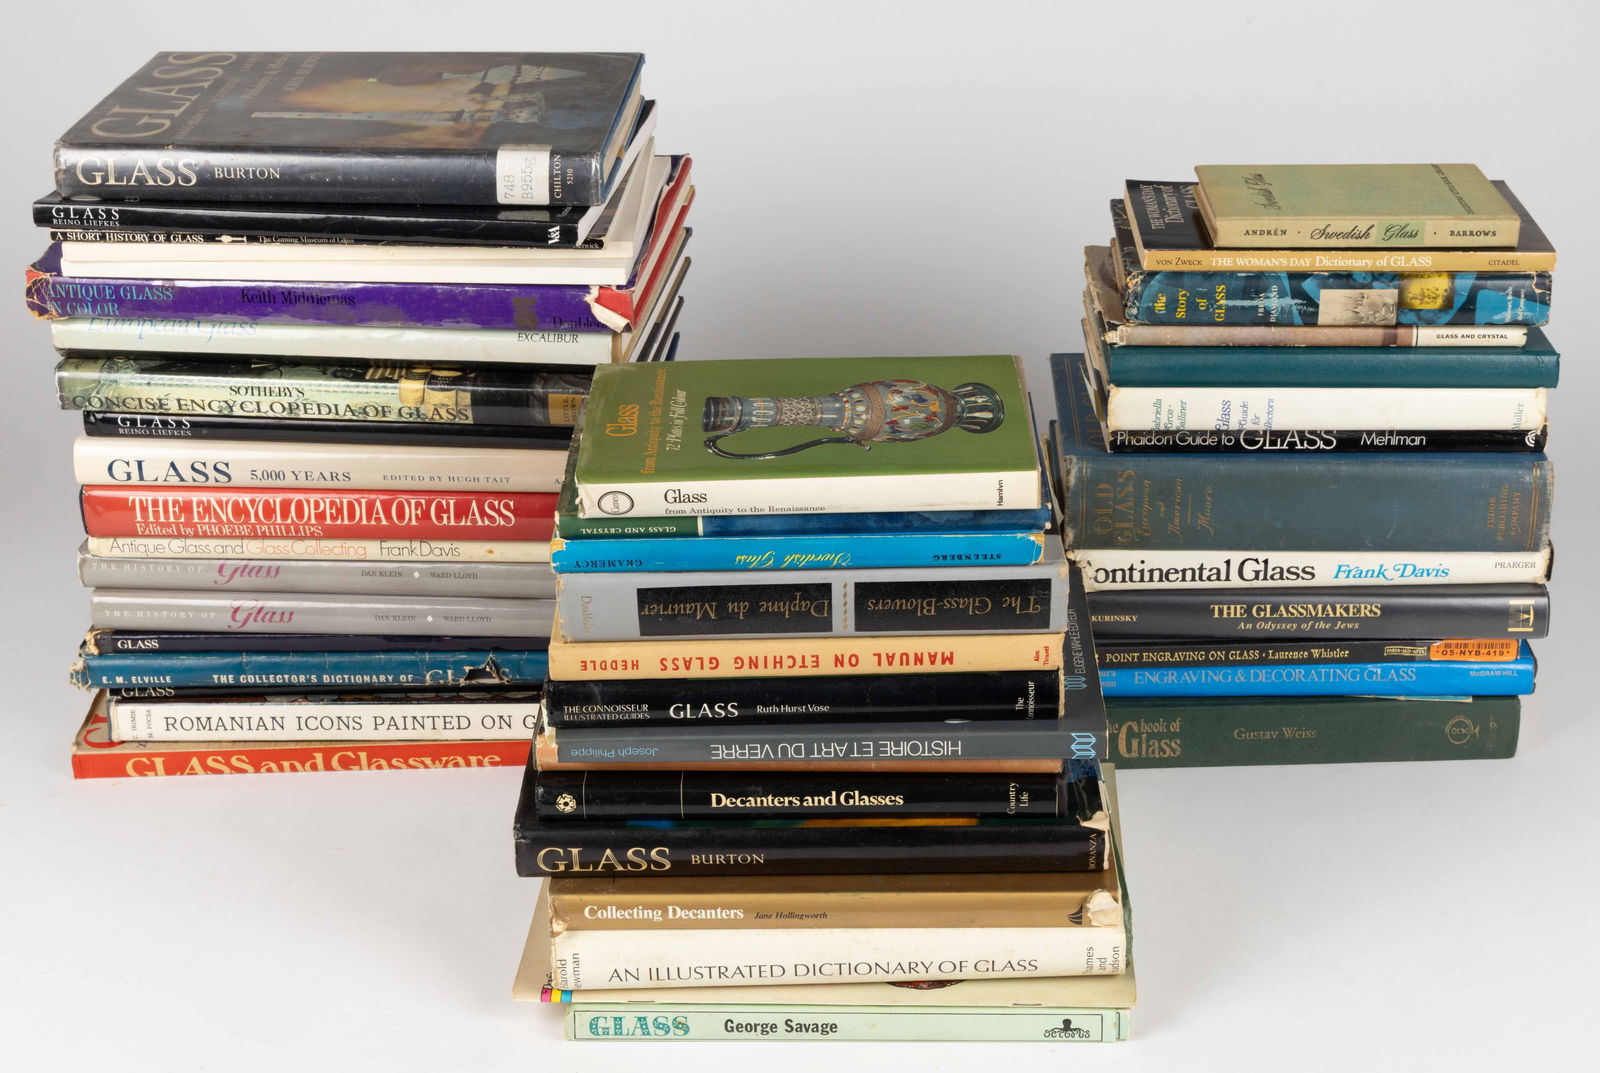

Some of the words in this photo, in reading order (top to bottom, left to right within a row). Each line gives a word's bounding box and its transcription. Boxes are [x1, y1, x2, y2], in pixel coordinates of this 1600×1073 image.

[92, 52, 238, 138] GLASS
[76, 157, 198, 186] GLASS
[214, 167, 281, 180] BURTON
[553, 154, 562, 200] CHILTON
[566, 168, 574, 185] 5210
[503, 174, 516, 201] 748
[52, 206, 120, 220] GLASS
[52, 218, 81, 226] REINO
[83, 219, 120, 227] LIEFKES
[66, 233, 101, 241] SHORT
[105, 233, 150, 242] HISTORY
[153, 234, 168, 242] OF
[170, 234, 204, 243] GLASS
[548, 225, 560, 244] V&A
[1243, 227, 1287, 236] ANDRÉN
[1310, 223, 1375, 240] Swedish
[1382, 223, 1419, 241] Glass
[1209, 257, 1233, 267] THE
[1236, 257, 1287, 267] WOMAN'S
[1289, 257, 1312, 267] DAY
[1315, 256, 1372, 268] Dictionary
[1376, 256, 1389, 267] of
[1390, 256, 1432, 267] GLASS
[46, 285, 116, 301] ANTIQUE
[120, 286, 174, 300] GLASS
[241, 289, 277, 304] Keith
[281, 291, 356, 306] Middlemas
[1175, 288, 1189, 319] Story
[1215, 284, 1227, 322] GLASS
[1270, 285, 1278, 322] DIAMOND
[517, 332, 579, 343] EXCALIBUR
[229, 386, 305, 398] SOTHEBY'S
[71, 395, 170, 411] CONCISE
[176, 398, 355, 417] ENCYCLOPEDIA
[362, 404, 392, 418] OF
[397, 405, 470, 421] GLASS
[605, 404, 640, 438] Glass
[1117, 432, 1173, 446] Phaidon
[1176, 432, 1218, 446] Guide
[1221, 433, 1235, 446] to
[1240, 430, 1337, 450] GLASS
[1361, 431, 1426, 446] Mehlman
[107, 459, 233, 484] GLASS
[250, 470, 286, 482] 5,000
[290, 470, 351, 482] YEARS
[663, 489, 708, 504] Glass
[129, 496, 185, 523] THE
[192, 496, 389, 525] ENCYCLOPEDIA
[391, 498, 426, 526] OF
[430, 499, 515, 527] GLASS
[664, 507, 687, 516] from
[689, 506, 734, 516] Antiquity
[738, 506, 747, 514] to
[749, 505, 766, 514] the
[768, 503, 826, 514] Renaissance
[137, 524, 178, 536] Edited
[180, 524, 195, 537] by
[198, 524, 253, 537] PHOEBE
[256, 525, 324, 537] PHILLIPS
[580, 526, 622, 535] CRYSTAL
[624, 526, 646, 534] AND
[109, 538, 166, 556] Antique
[168, 538, 212, 555] Glass
[214, 538, 244, 556] and
[245, 538, 290, 556] Glass
[290, 539, 368, 560] Collecting
[379, 540, 419, 557] Frank
[419, 540, 461, 558] Davis
[1237, 557, 1316, 582] Glass
[1332, 564, 1393, 582] Frank
[1393, 562, 1450, 579] Davis
[1494, 561, 1537, 569] PRAEGER
[640, 601, 718, 620] Maurier
[727, 601, 749, 620] du
[759, 592, 829, 619] Daphne
[867, 597, 993, 617] Glass-Blowers
[1002, 595, 1042, 615] The
[1091, 614, 1139, 622] KURINSKY
[1210, 604, 1247, 618] THE
[1251, 603, 1382, 618] GLASSMAKERS
[117, 639, 160, 649] GLASS
[659, 656, 720, 672] GLASS
[733, 654, 820, 670] ETCHING
[833, 653, 860, 667] ON
[873, 651, 955, 667] MANUAL
[1105, 653, 1140, 663] POINT
[1142, 650, 1206, 662] ENGRAVING
[1208, 650, 1226, 661] ON
[1228, 650, 1260, 660] GLASS
[1267, 649, 1308, 660] Laurence
[1310, 648, 1350, 659] Whistler
[580, 659, 640, 671] HEDDLE
[115, 675, 128, 684] M.
[131, 675, 172, 684] ELVILLE
[212, 674, 235, 684] THE
[239, 674, 318, 684] COLLECTOR'S
[323, 674, 394, 684] DICTIONARY
[400, 674, 414, 683] OF
[1133, 670, 1232, 685] ENGRAVING
[1255, 667, 1363, 683] DECORATING
[1363, 667, 1417, 682] GLASS
[562, 705, 581, 714] THE
[582, 704, 649, 714] CONNOISSEUR
[669, 702, 739, 719] GLASS
[756, 704, 779, 714] Ruth
[780, 704, 807, 714] Hurst
[807, 703, 830, 713] Vose
[564, 713, 615, 722] ILLUSTRATED
[615, 712, 651, 721] GUIDES
[164, 716, 285, 732] ROMANIAN
[296, 715, 363, 731] ICONS
[372, 715, 471, 731] PAINTED
[481, 715, 513, 730] ON
[570, 747, 615, 758] Philippe
[616, 746, 659, 758] Joseph
[710, 743, 775, 760] VERRE
[777, 742, 806, 759] DU
[810, 742, 848, 758] ART
[853, 741, 873, 757] ET
[879, 740, 962, 756] HISTOIRE
[125, 755, 255, 777] GLASS
[259, 752, 324, 773] and
[330, 750, 502, 772] Glassware
[710, 793, 800, 808] Decanters
[803, 790, 837, 807] and
[839, 790, 904, 807] Glasses
[536, 846, 672, 873] GLASS
[690, 853, 765, 866] BURTON
[583, 905, 663, 922] Collecting
[667, 904, 745, 920] Decanters
[753, 911, 773, 920] Jane
[775, 911, 828, 921] Hollingworth
[608, 967, 641, 983] AN
[648, 963, 787, 982] ILLUSTRATED
[794, 960, 934, 978] DICTIONARY
[938, 960, 969, 974] OF
[973, 959, 1038, 973] GLASS
[588, 1015, 691, 1038] GLASS
[723, 1017, 779, 1035] George
[784, 1018, 838, 1036] Savage
